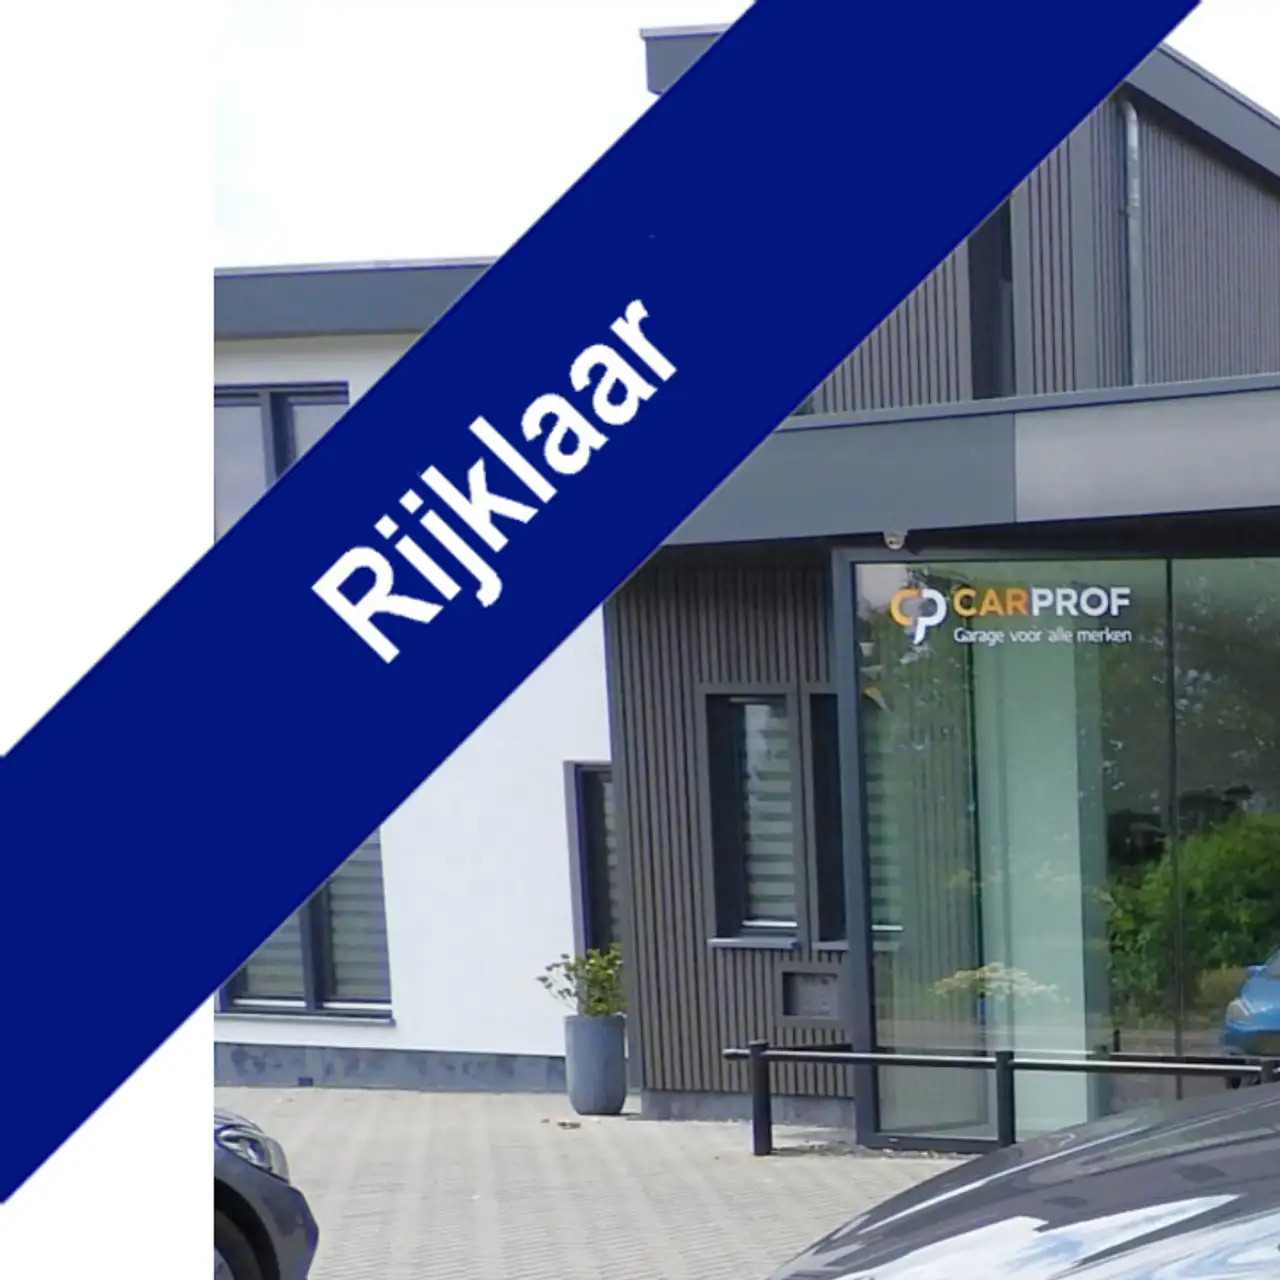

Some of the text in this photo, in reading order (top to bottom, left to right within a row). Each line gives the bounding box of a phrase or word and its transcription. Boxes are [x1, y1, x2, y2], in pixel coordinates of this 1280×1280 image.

[953, 586, 1131, 616] CARPROF
[953, 626, 1132, 647] Garage voor alle merken
